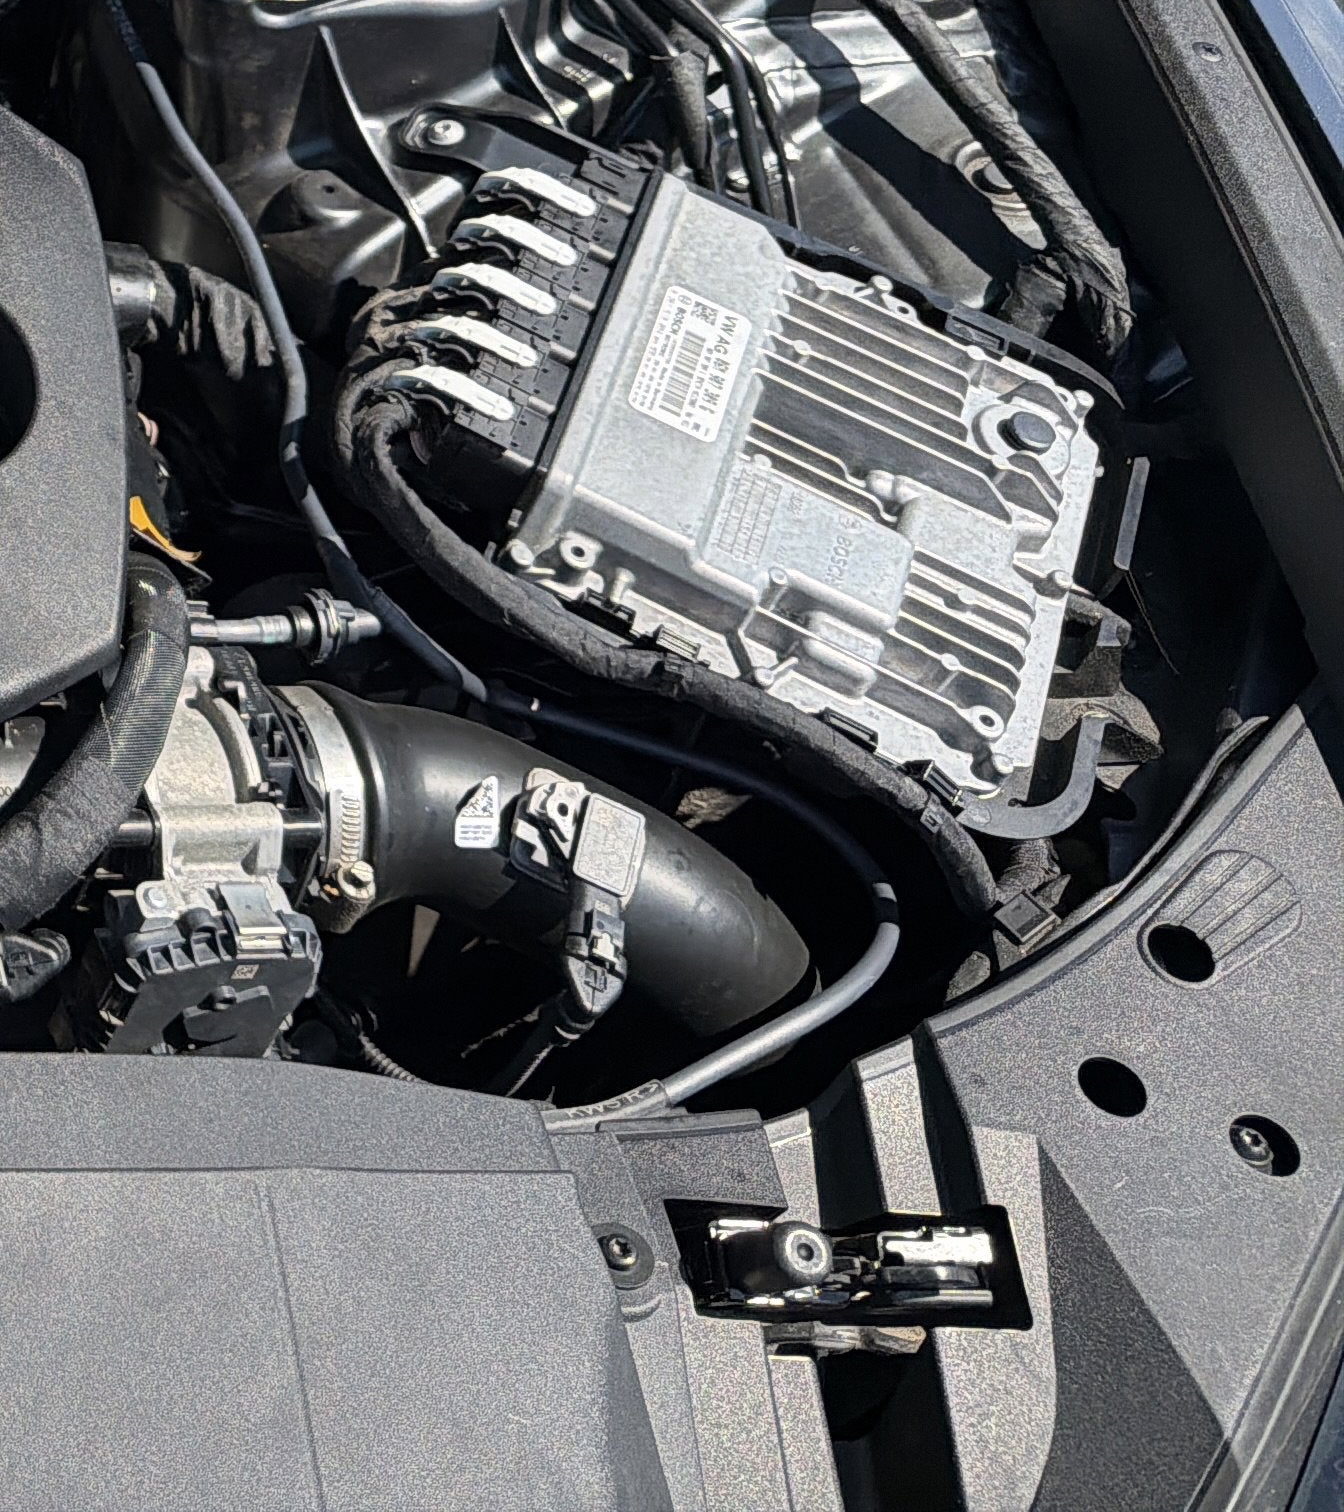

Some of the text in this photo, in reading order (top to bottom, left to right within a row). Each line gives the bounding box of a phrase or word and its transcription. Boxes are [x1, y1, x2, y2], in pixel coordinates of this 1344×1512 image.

[671, 307, 687, 335] BOSCH
[720, 314, 739, 337] VW
[713, 334, 732, 356] AG
